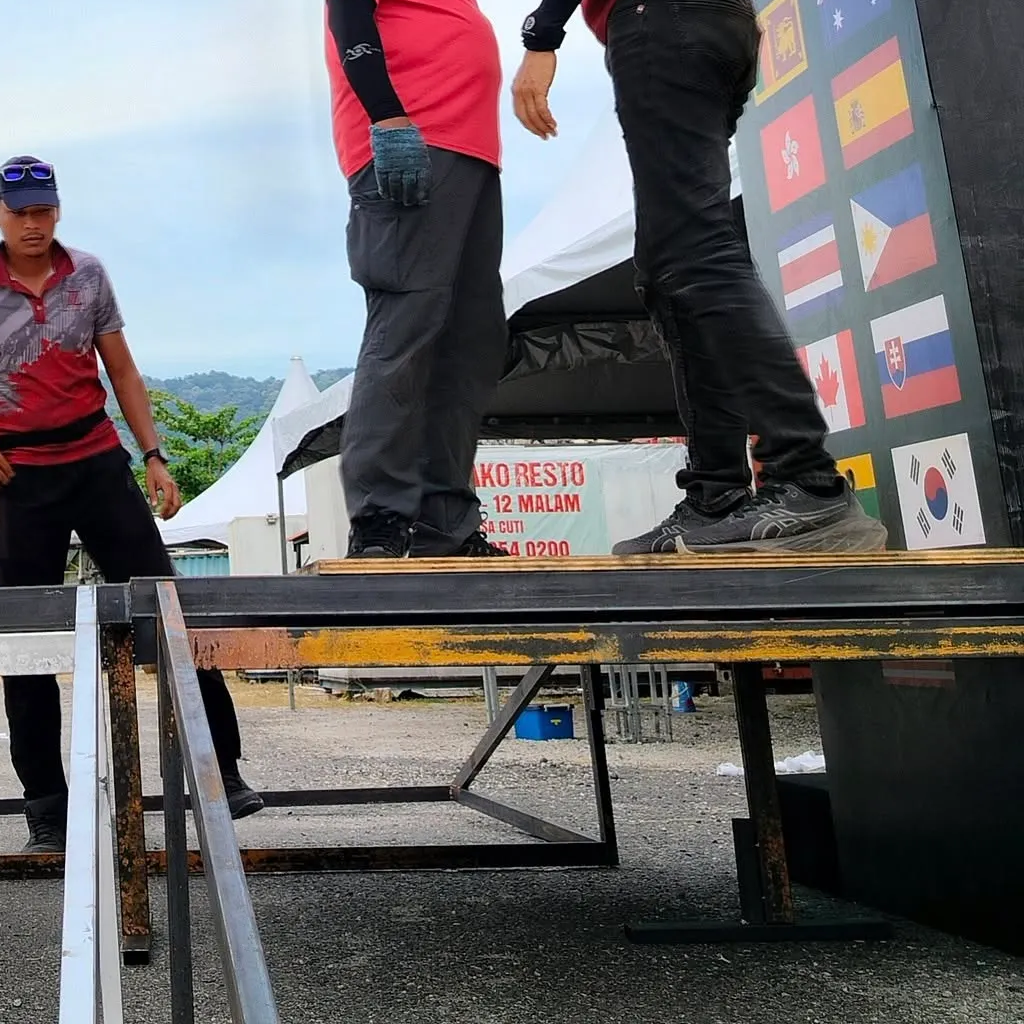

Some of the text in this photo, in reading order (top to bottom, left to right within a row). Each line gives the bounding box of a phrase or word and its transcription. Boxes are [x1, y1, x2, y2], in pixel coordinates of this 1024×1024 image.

[515, 461, 586, 487] RESTO
[492, 494, 512, 513] 12
[518, 493, 582, 513] MALAM
